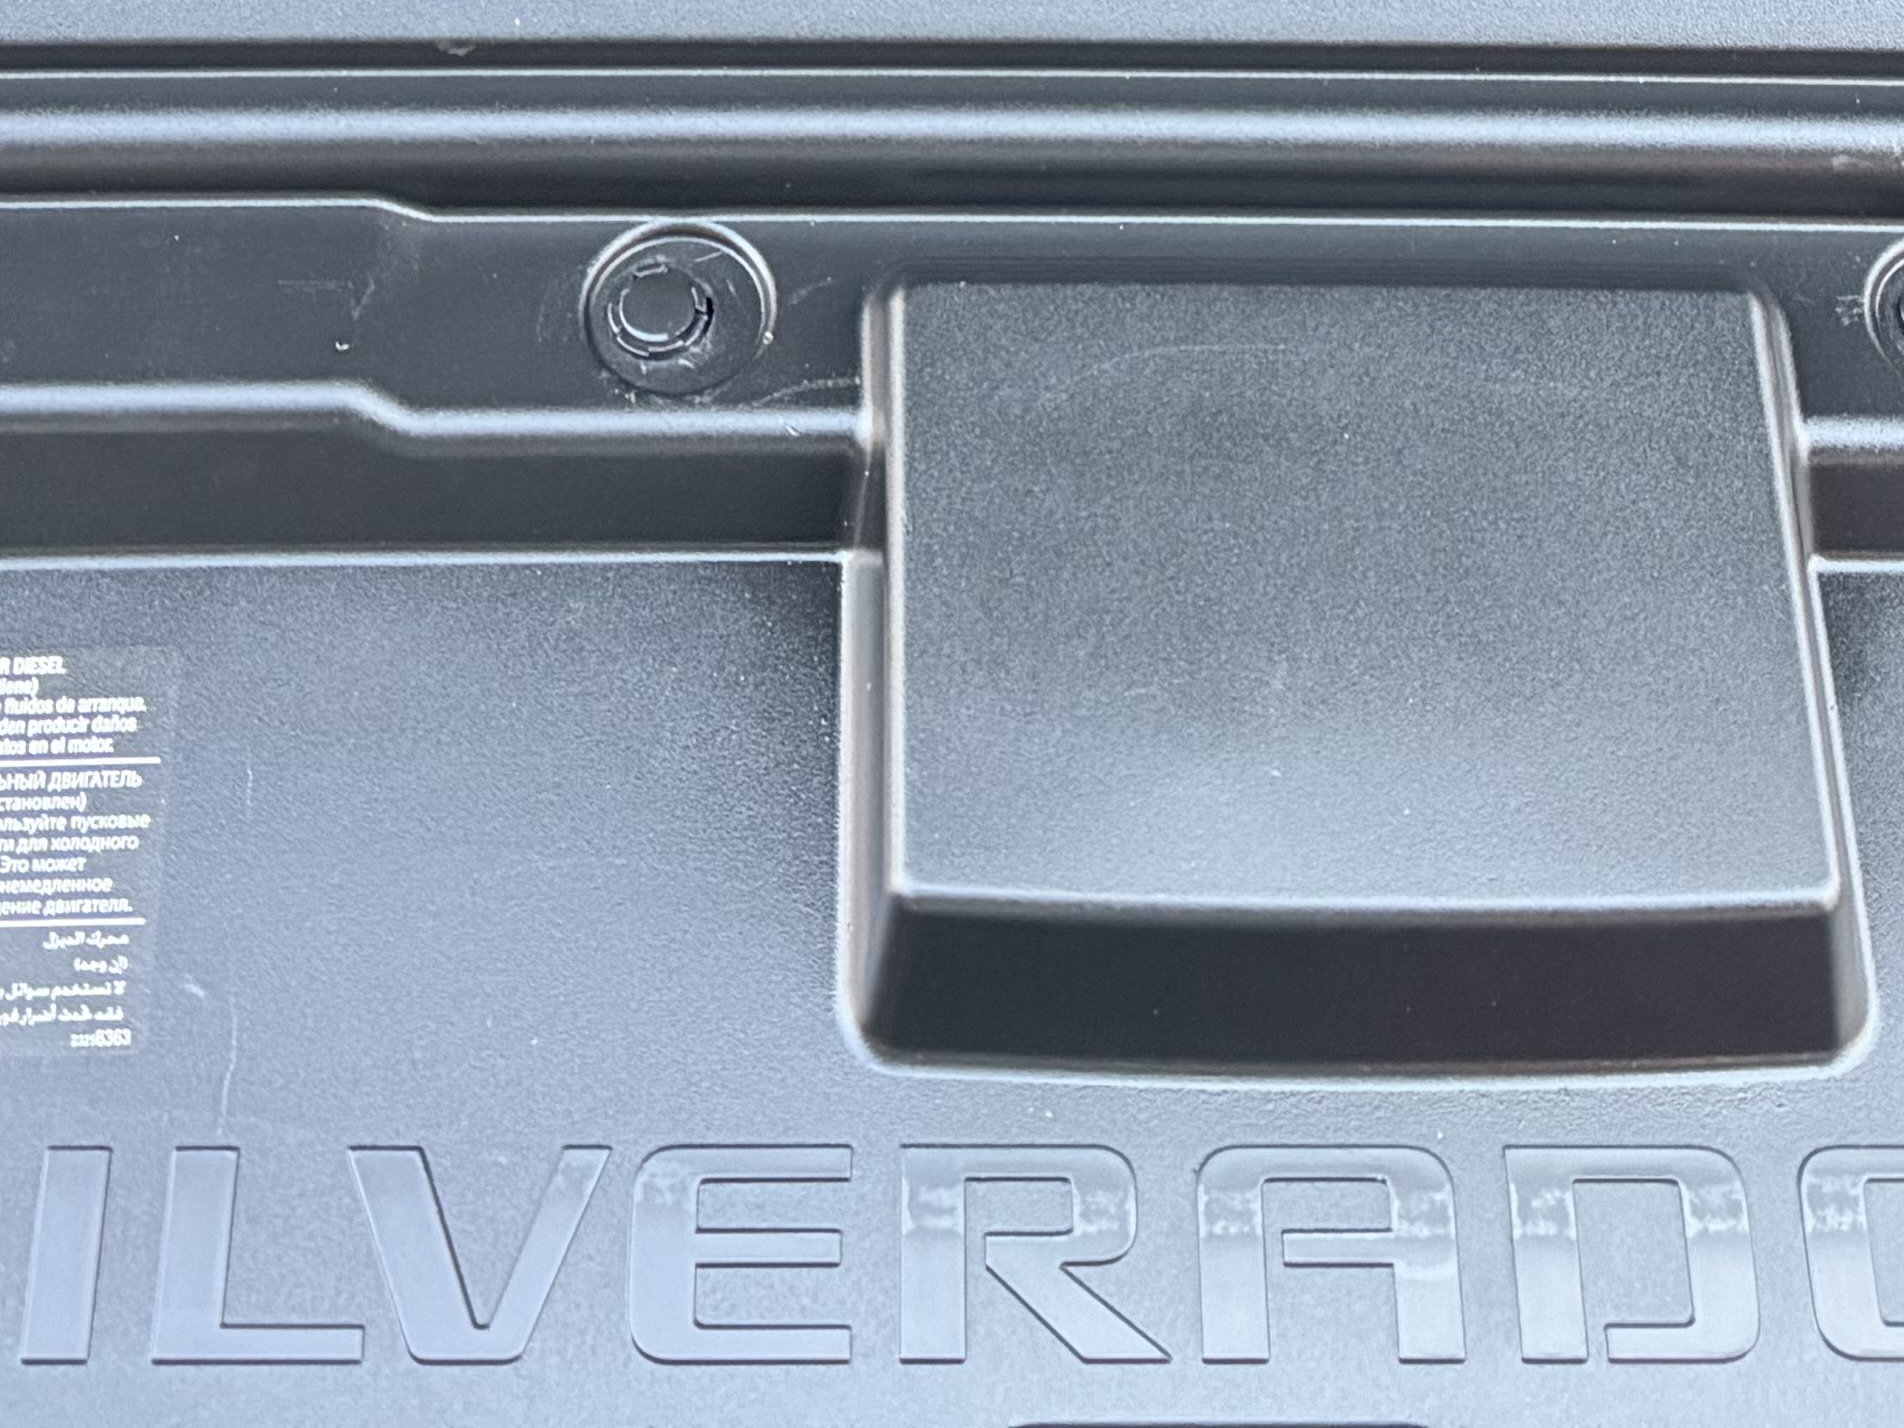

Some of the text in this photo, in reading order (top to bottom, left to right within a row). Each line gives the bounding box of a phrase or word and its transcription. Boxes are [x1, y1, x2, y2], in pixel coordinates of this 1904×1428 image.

[13, 656, 67, 674] DIESEL
[4, 698, 53, 714] fluidos
[56, 696, 75, 713] de
[78, 697, 146, 714] arranque.
[28, 716, 89, 736] producir
[92, 715, 137, 732] daños
[29, 740, 48, 754] en
[51, 737, 66, 754] el
[68, 738, 114, 753] motor.
[48, 770, 143, 792] ДВИГАТЕЛЬ
[71, 814, 150, 834] пусковые
[16, 838, 48, 854] для
[51, 836, 139, 853] холодного
[32, 857, 86, 872] может
[0, 877, 113, 895] немедленное
[43, 898, 133, 917] двигателя.
